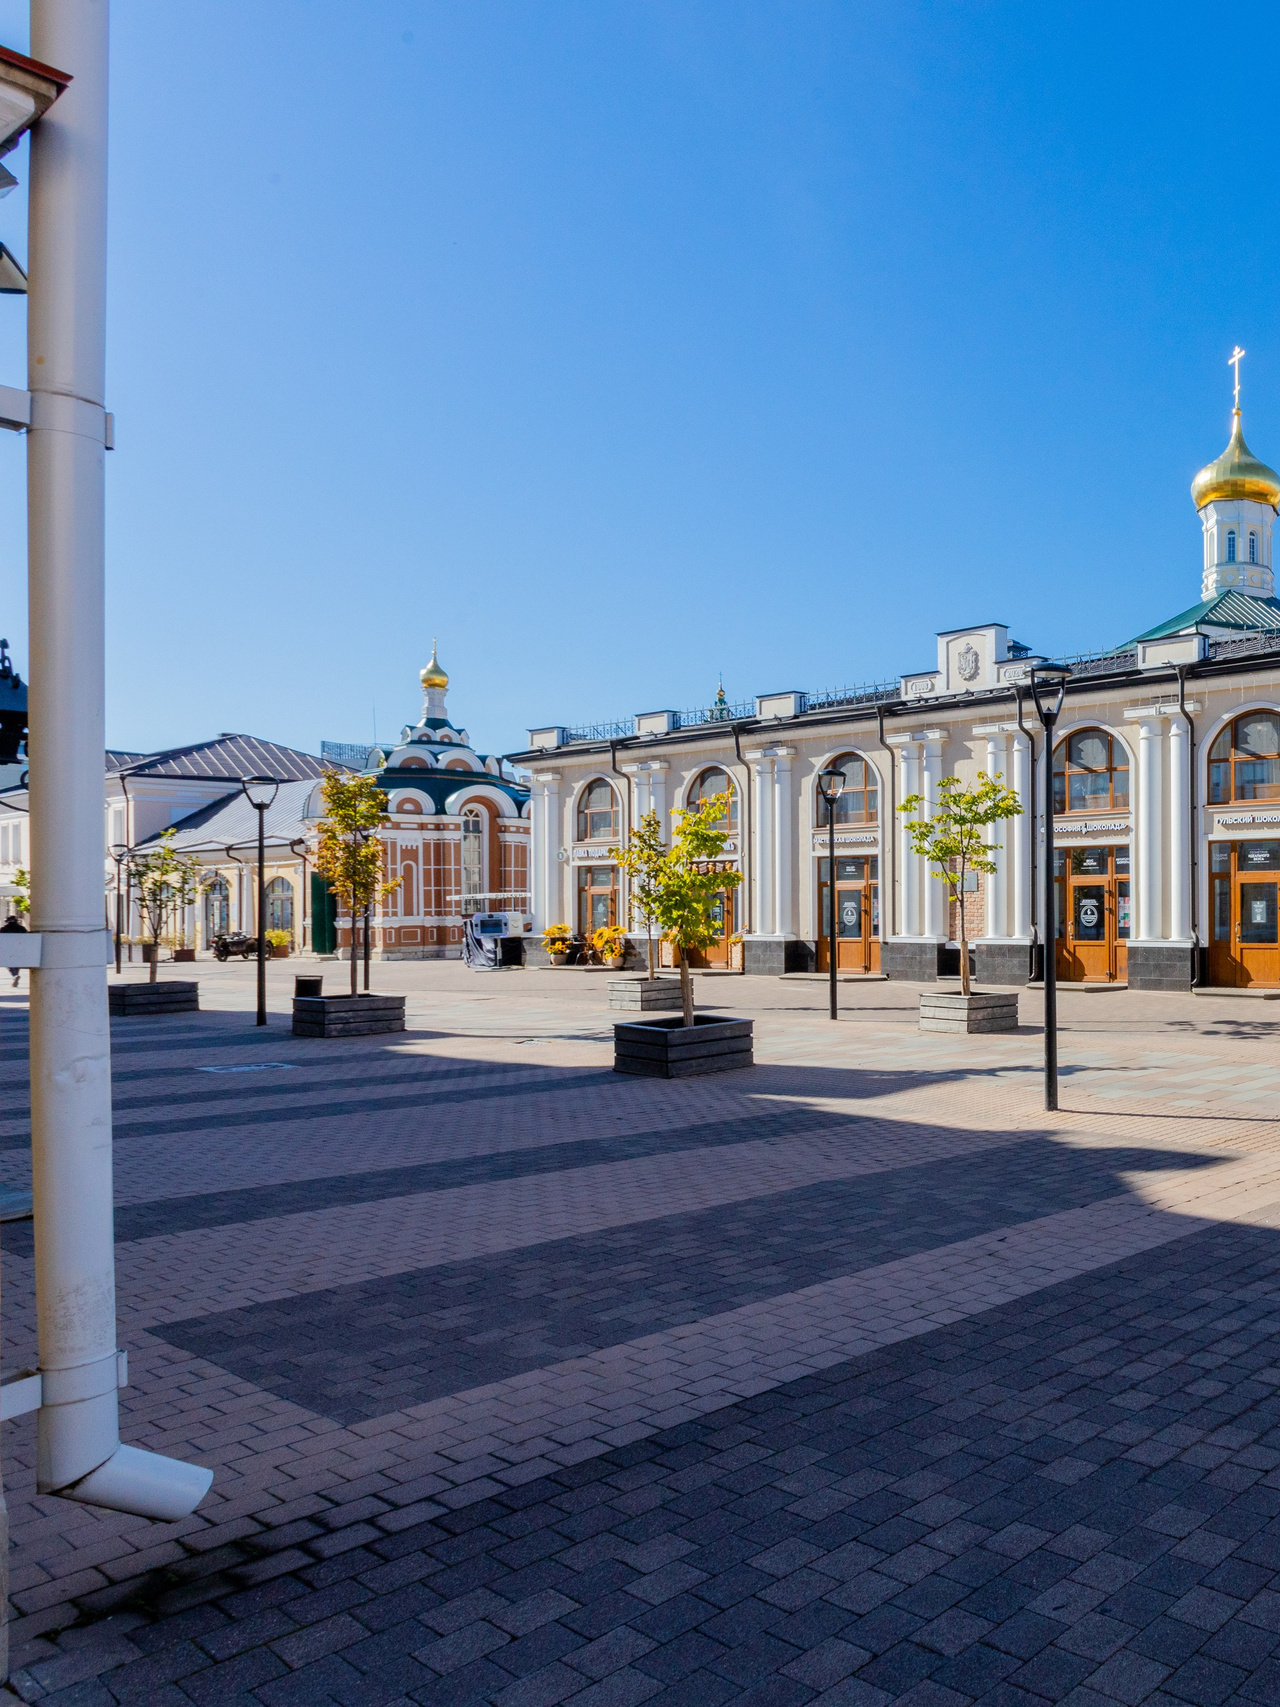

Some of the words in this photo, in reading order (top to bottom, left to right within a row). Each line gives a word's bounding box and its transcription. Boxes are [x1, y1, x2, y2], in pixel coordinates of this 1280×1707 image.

[1216, 814, 1253, 825] ТУЛЬСКИЙ
[1040, 822, 1081, 833] ФОСОФИЯ
[1087, 823, 1126, 832] ШОКОЛАДА
